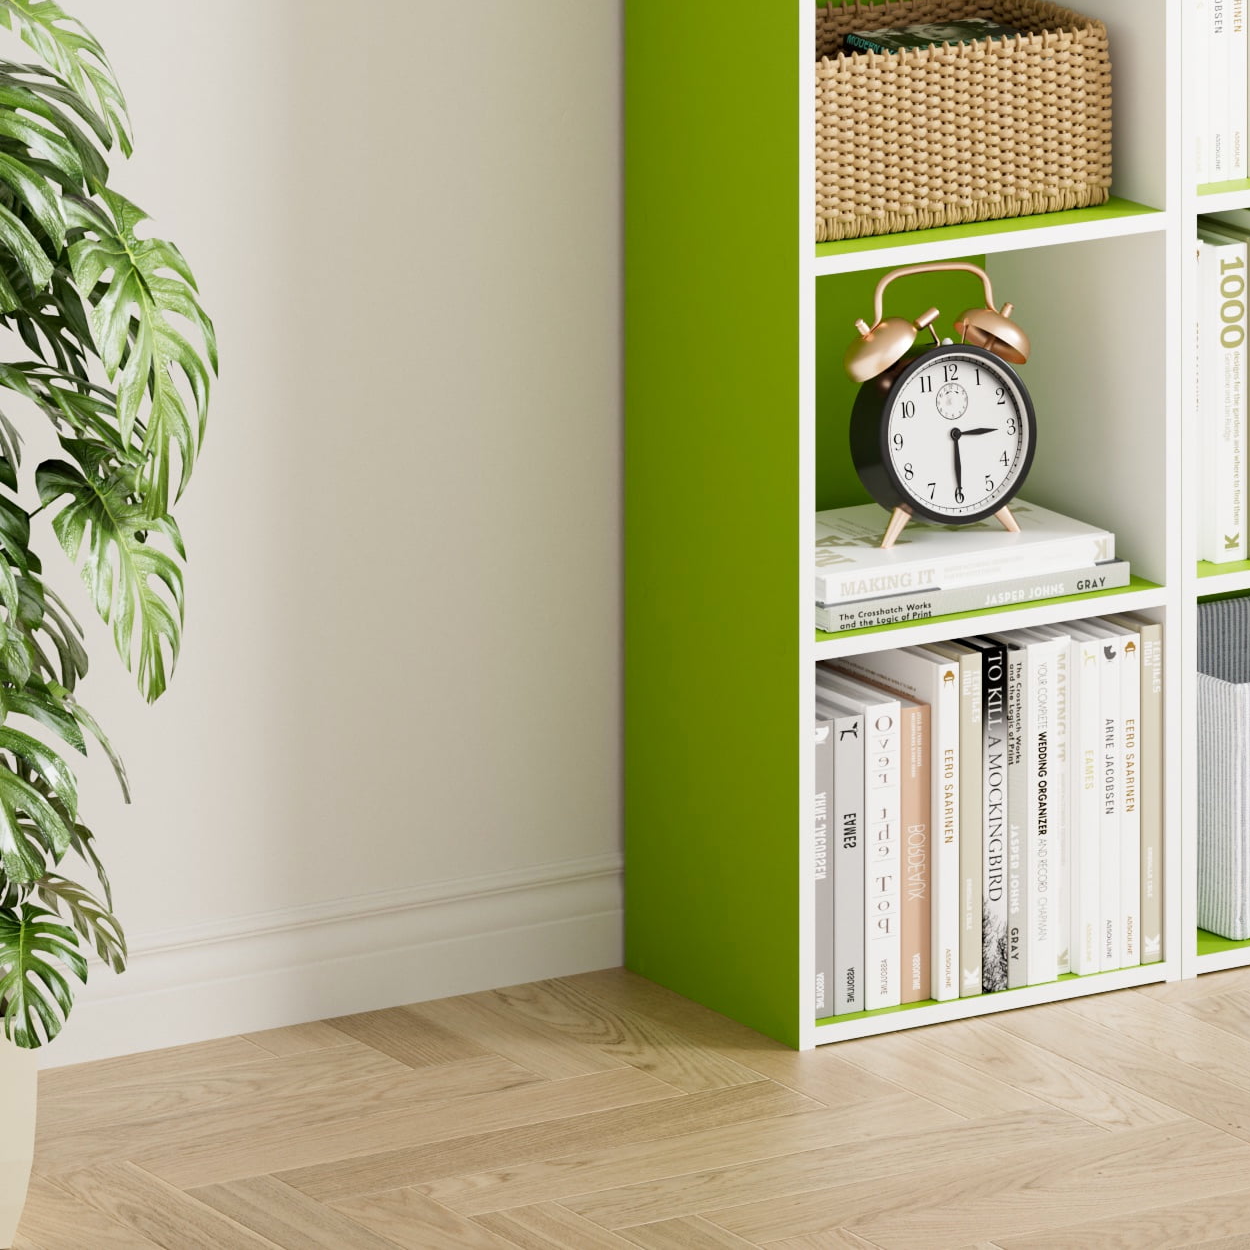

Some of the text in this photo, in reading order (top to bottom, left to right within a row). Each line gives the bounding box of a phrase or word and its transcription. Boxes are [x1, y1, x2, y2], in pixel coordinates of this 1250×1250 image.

[1219, 255, 1245, 349] 1000
[943, 363, 958, 382] 12
[974, 368, 981, 385] 1
[920, 375, 932, 393] 11
[995, 387, 1005, 405] 2
[901, 400, 915, 418] 10
[1006, 417, 1016, 435] 3
[893, 433, 903, 451] 9
[999, 450, 1010, 466] 4
[1232, 455, 1241, 478] where
[904, 463, 914, 480] 8
[927, 482, 936, 500] 7
[985, 474, 994, 491] 5
[1232, 505, 1241, 526] them
[841, 569, 936, 597] MAKING IT
[1076, 576, 1107, 591] GRAY
[984, 583, 1065, 605] JASPER JOHNS
[839, 602, 932, 621] The Crosshatch Works
[840, 610, 933, 630] and the Logic of Print
[1084, 750, 1094, 790] EAMES
[1104, 718, 1115, 815] ARNE JACOBSEN
[1124, 718, 1135, 813] EERO SAARINEN
[987, 650, 1004, 902] TO KILL A MOCKINGBIRD
[1037, 731, 1048, 836] WEDDING ORGANIZER
[944, 749, 954, 844] EERO SAARINEN
[1010, 927, 1019, 961] GRAY
